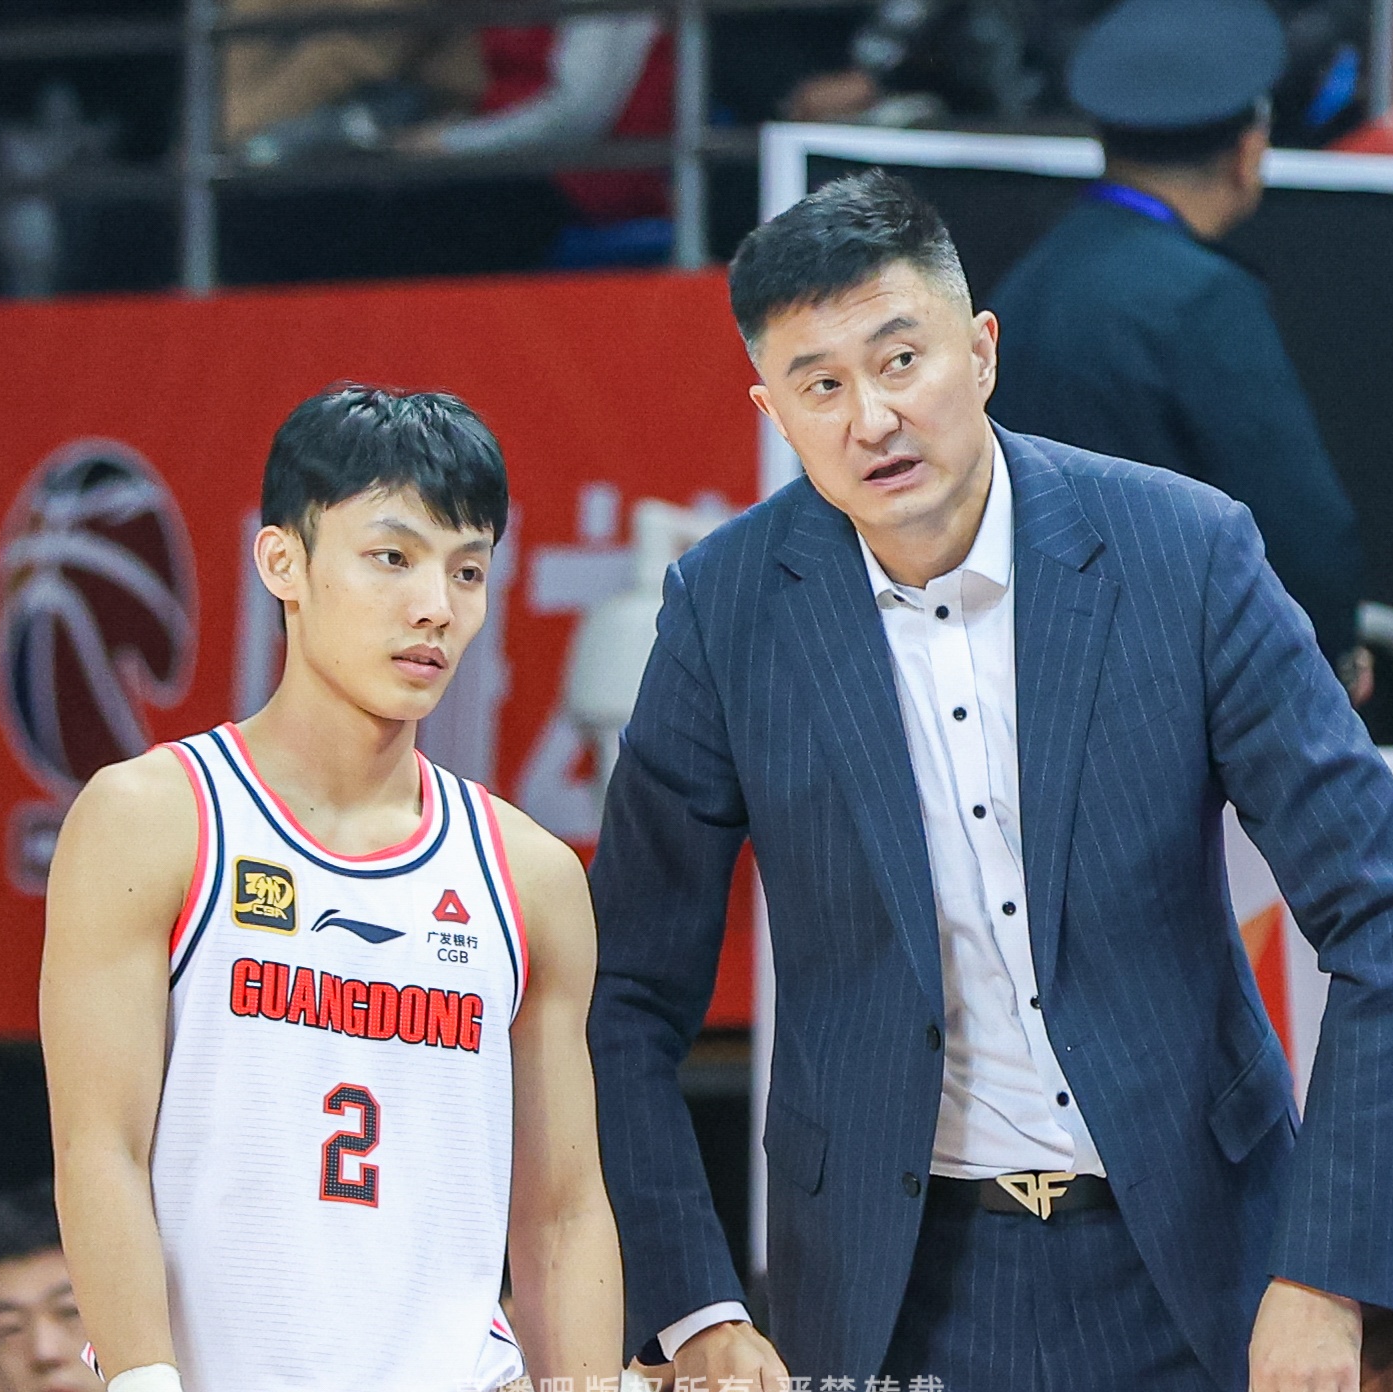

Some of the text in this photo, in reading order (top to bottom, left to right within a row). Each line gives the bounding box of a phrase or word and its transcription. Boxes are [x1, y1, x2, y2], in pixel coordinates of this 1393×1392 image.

[427, 931, 478, 950] 广发银行
[437, 948, 469, 964] CGB
[230, 957, 484, 1054] GUANGDONG
[319, 1082, 381, 1208] 2
